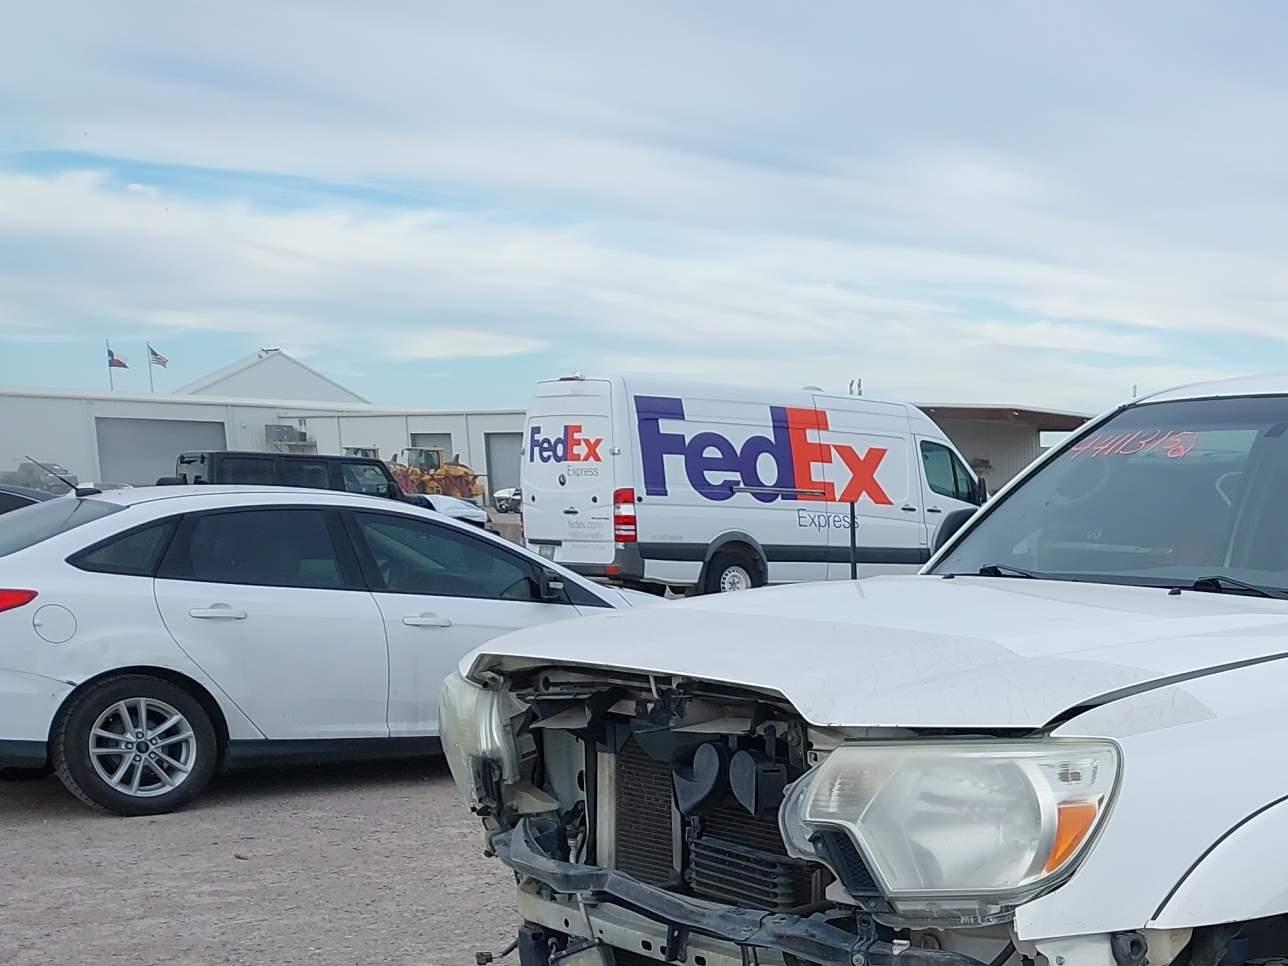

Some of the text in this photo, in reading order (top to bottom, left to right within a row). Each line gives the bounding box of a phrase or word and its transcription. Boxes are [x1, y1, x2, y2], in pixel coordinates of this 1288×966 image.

[529, 425, 604, 462] FedEx
[634, 395, 894, 505] FedEx
[567, 465, 599, 477] Express
